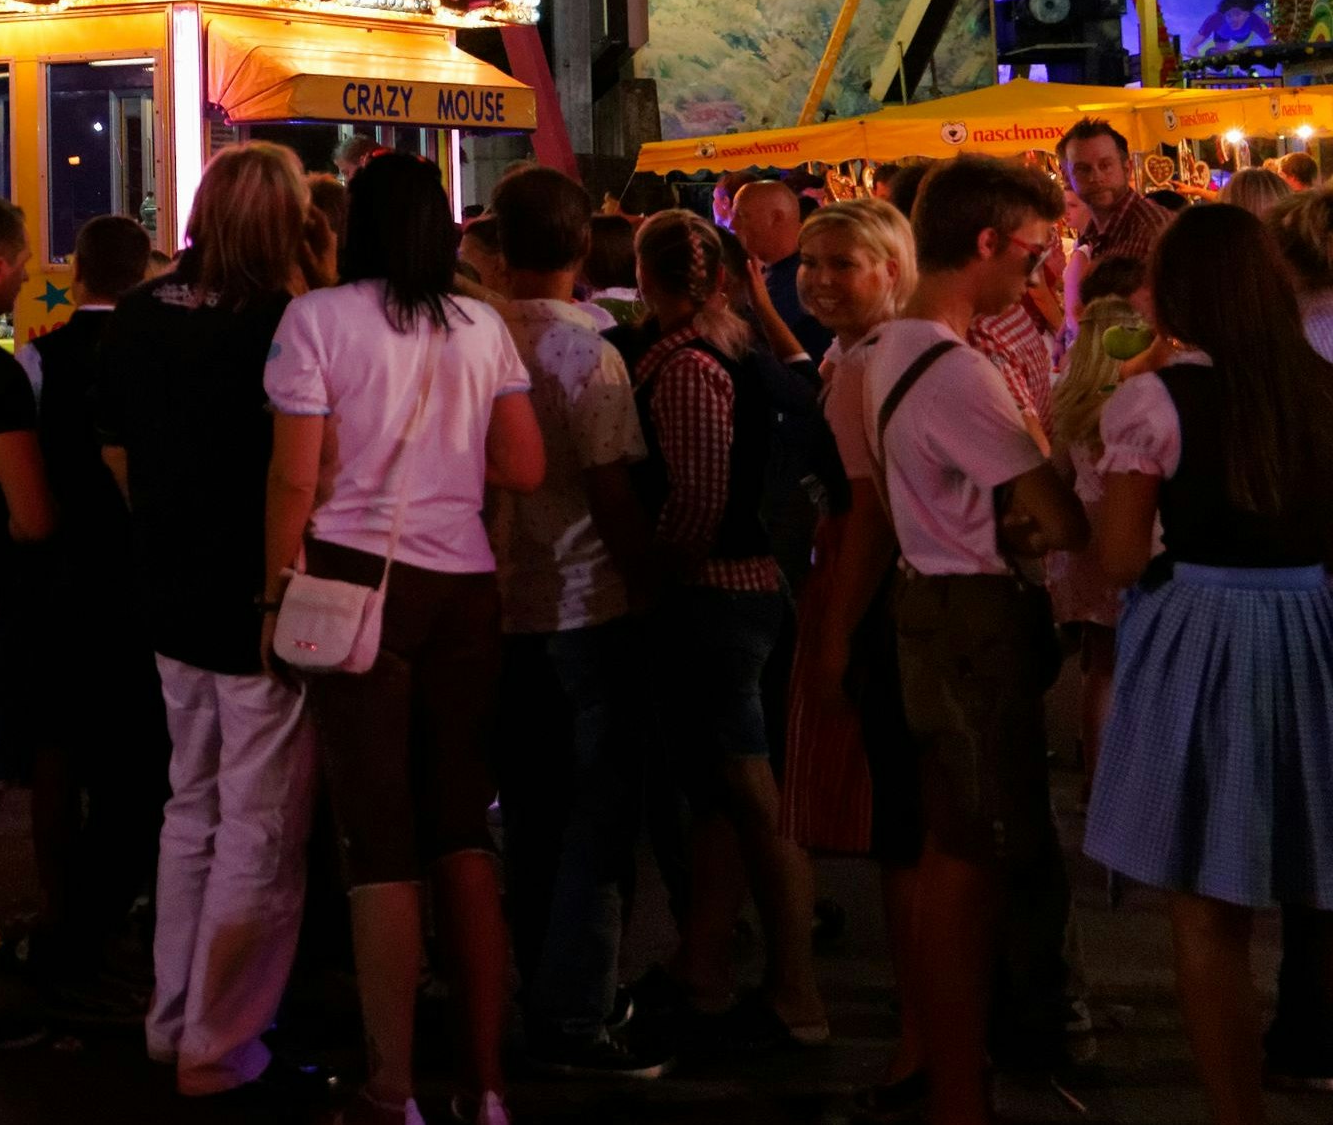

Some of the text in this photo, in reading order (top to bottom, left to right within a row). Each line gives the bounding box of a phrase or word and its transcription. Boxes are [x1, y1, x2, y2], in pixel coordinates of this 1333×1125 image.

[342, 82, 505, 123] CRAZY MOUSE
[972, 123, 1066, 144] naschmax
[720, 139, 801, 158] naschmax
